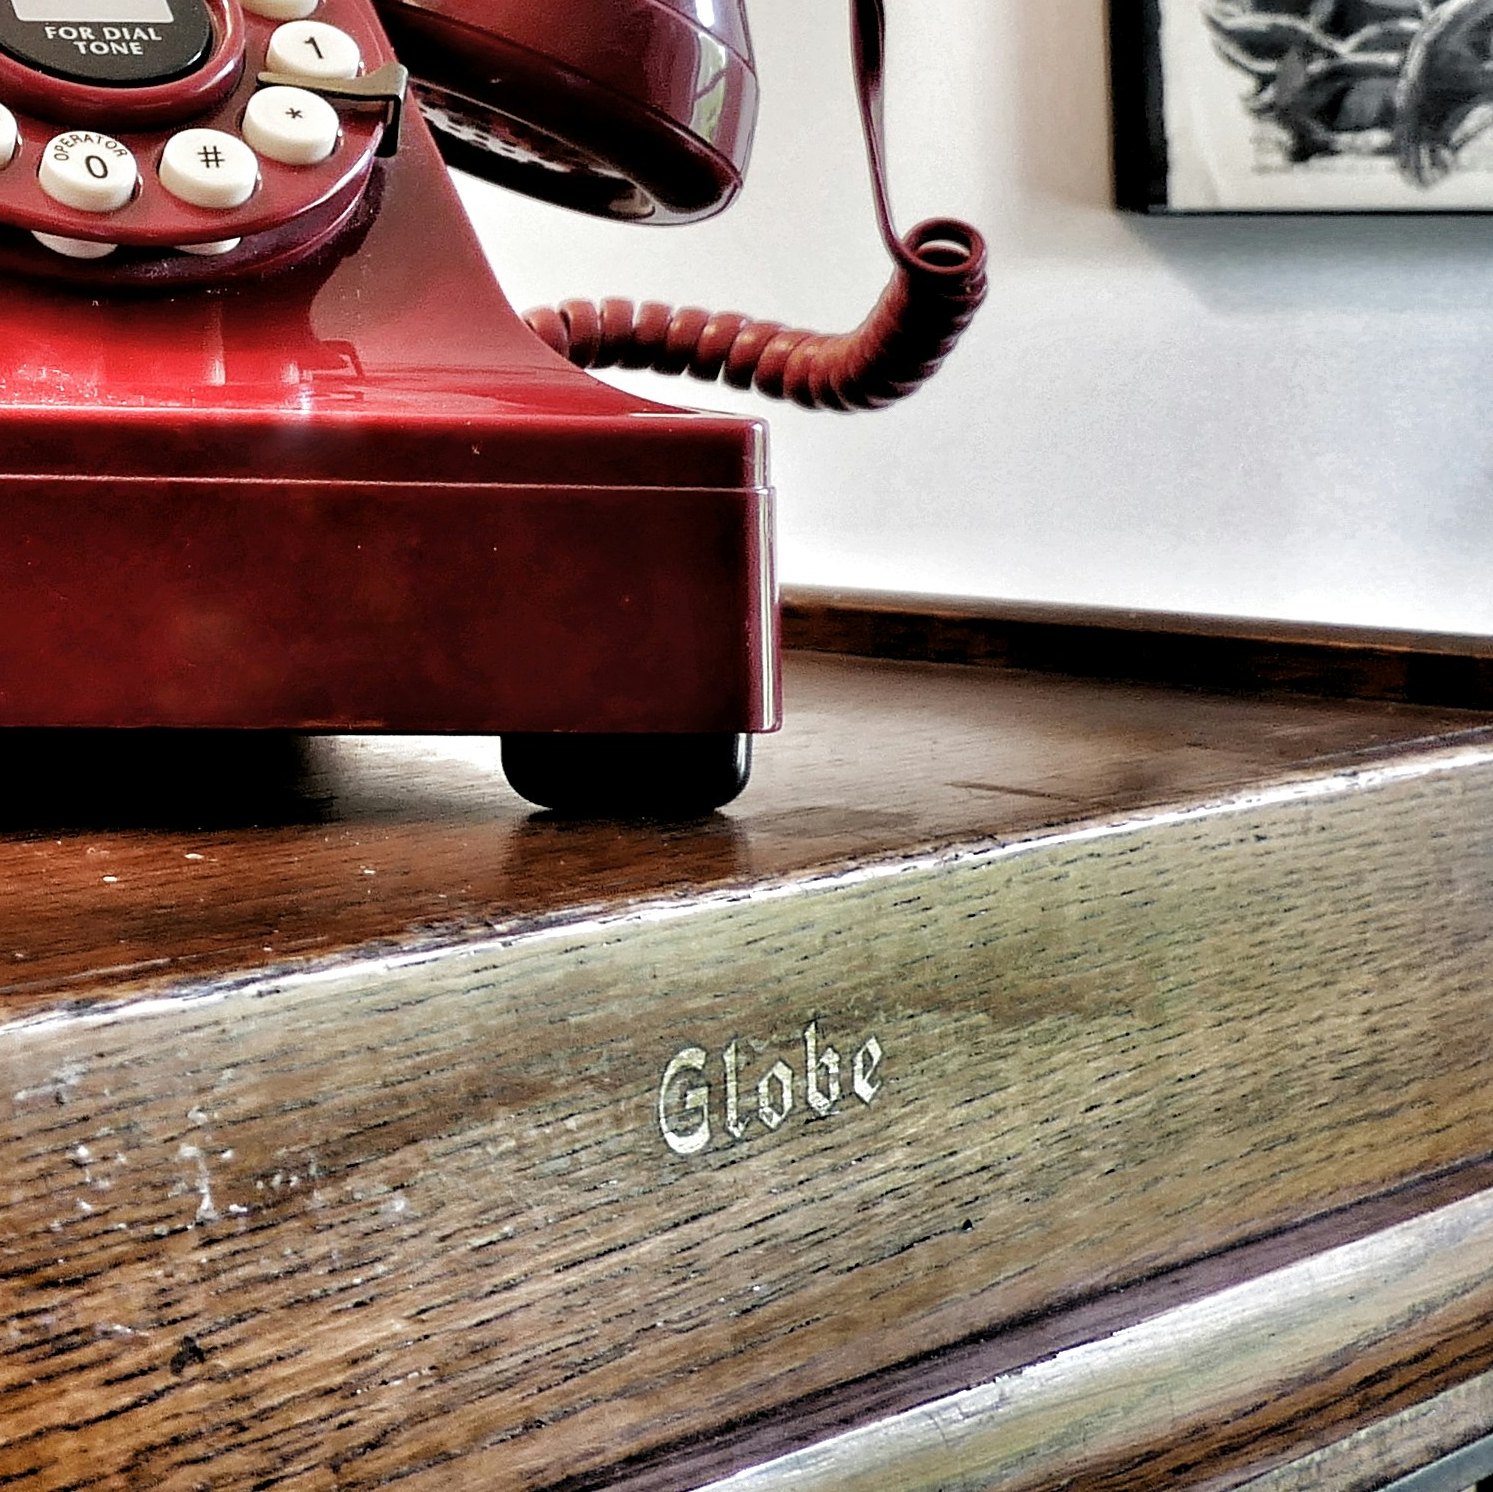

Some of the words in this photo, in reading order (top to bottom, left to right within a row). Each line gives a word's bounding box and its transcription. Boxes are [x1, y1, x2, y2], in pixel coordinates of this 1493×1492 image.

[44, 26, 96, 40] FOR
[102, 26, 163, 41] DIAL
[73, 41, 144, 55] TONE
[304, 36, 324, 59] 1
[54, 133, 128, 161] OPERATOR
[84, 155, 108, 179] 0
[659, 1021, 883, 1154] Globe
